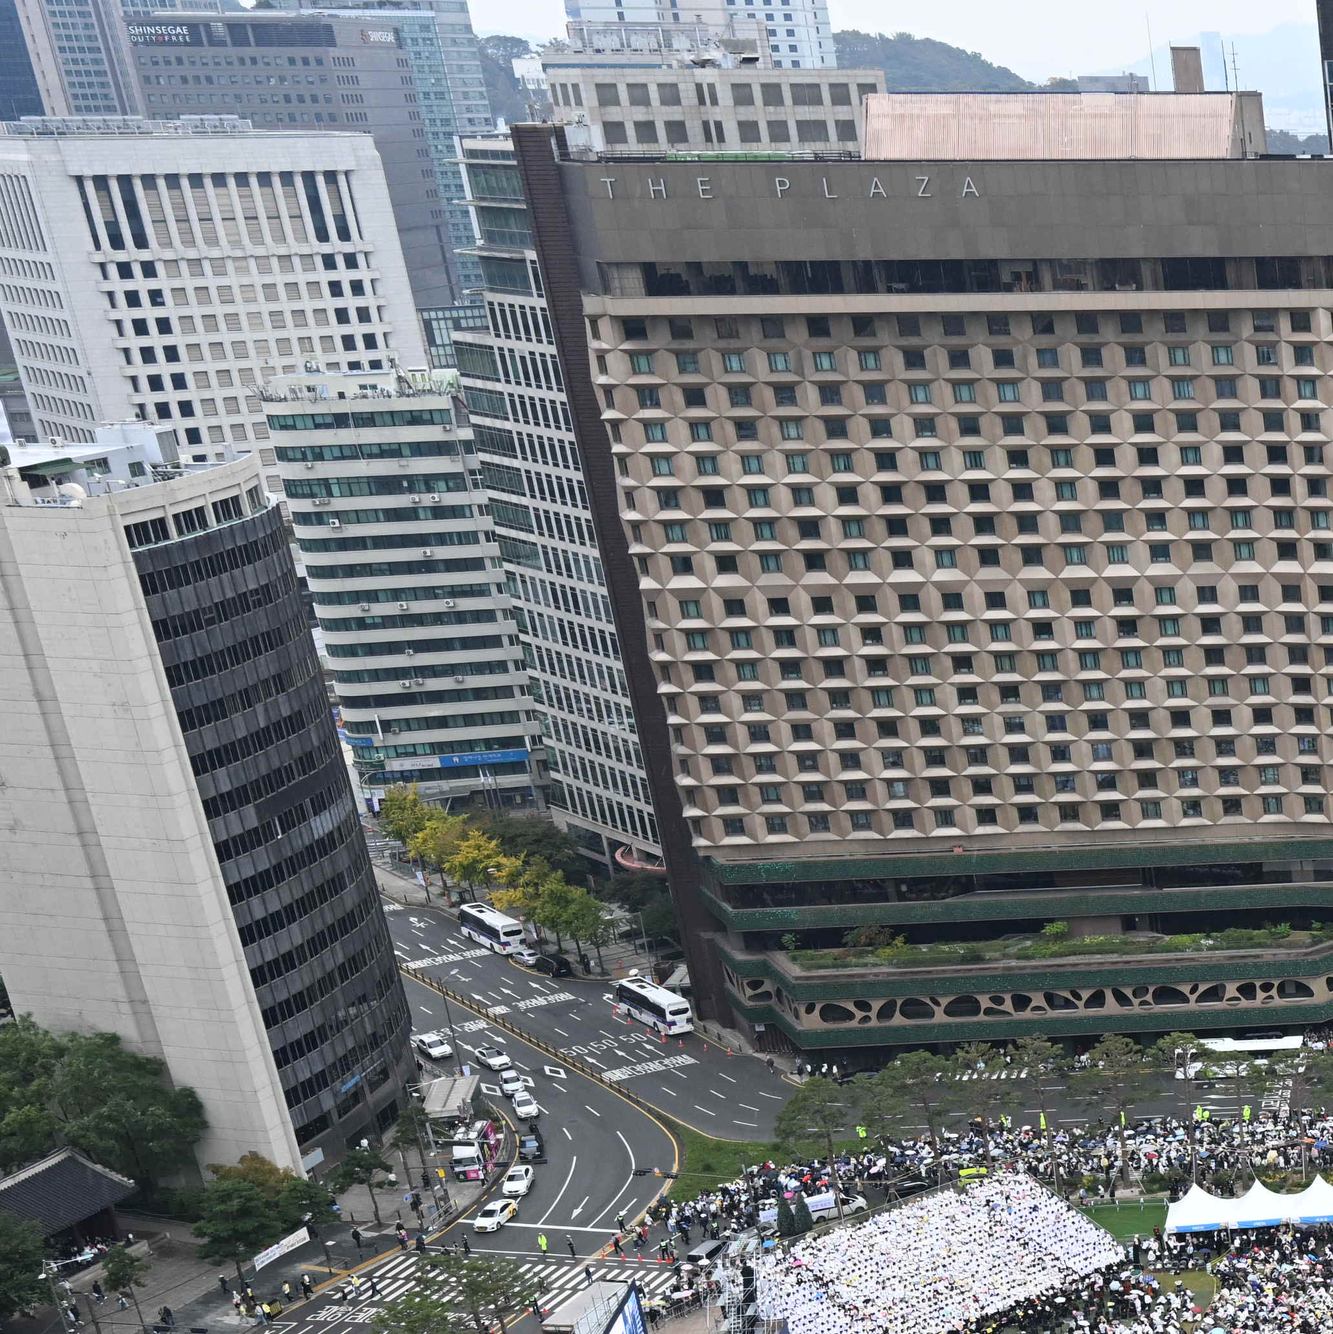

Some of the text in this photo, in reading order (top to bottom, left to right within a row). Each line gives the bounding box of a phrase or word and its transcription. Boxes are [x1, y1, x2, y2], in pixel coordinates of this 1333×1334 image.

[128, 25, 188, 35] SHINSEGAE
[130, 35, 190, 43] DUTY FREE
[367, 31, 396, 43] SHINSEGAE
[601, 176, 980, 200] THE PLAZA
[590, 1039, 618, 1048] 50
[619, 1032, 647, 1044] 50
